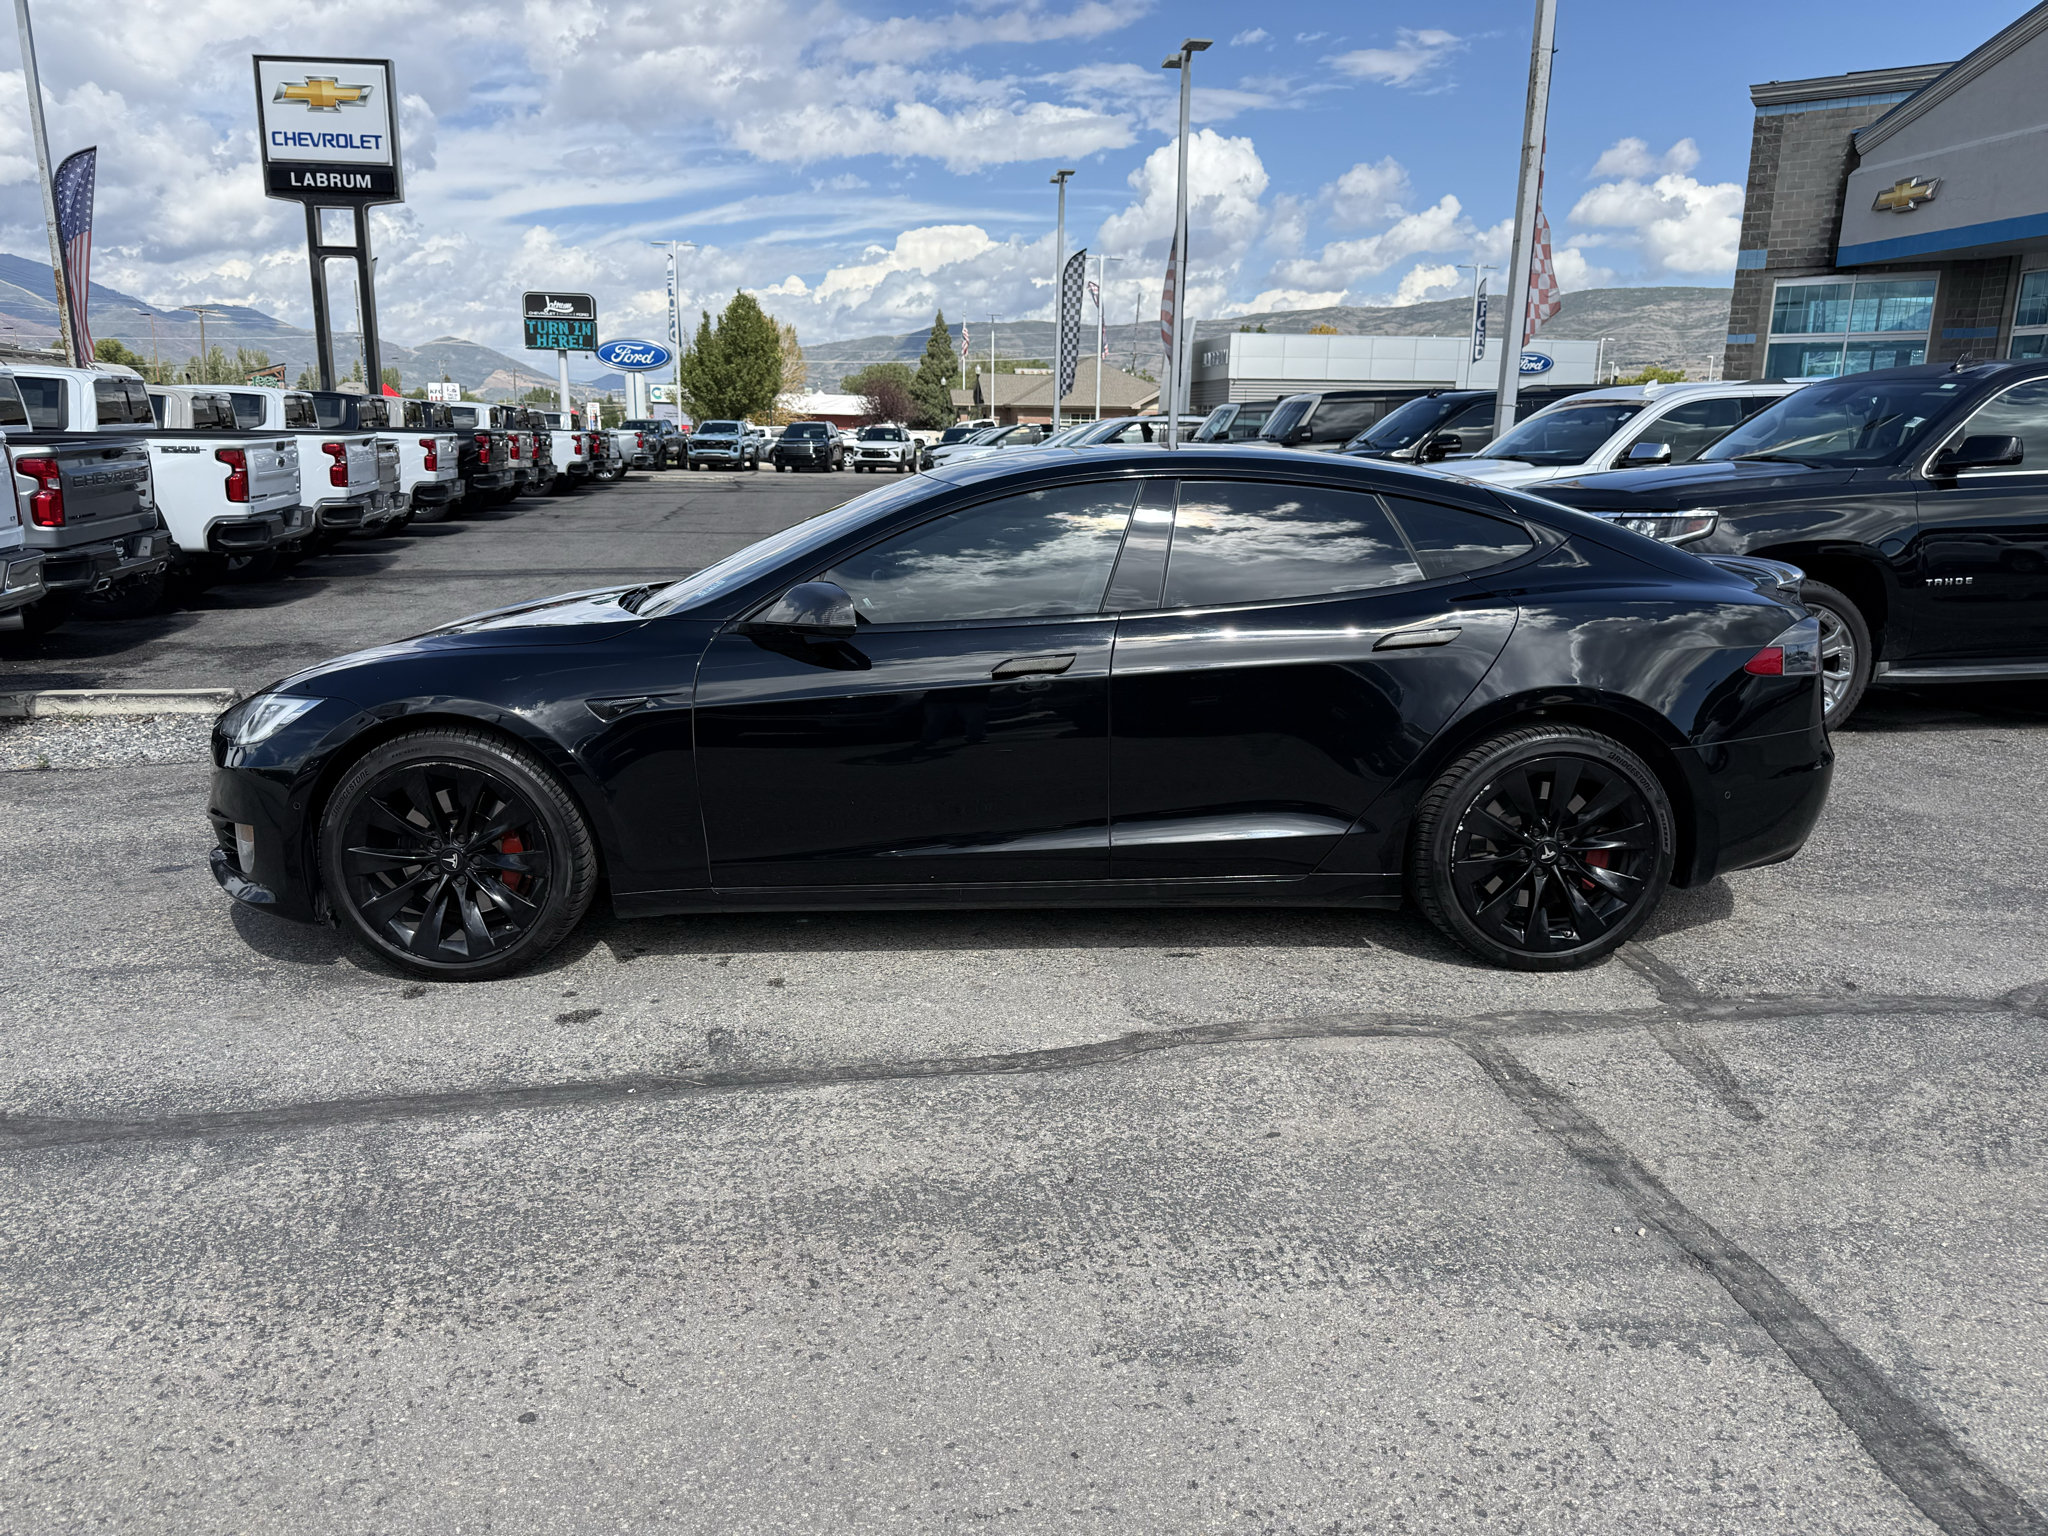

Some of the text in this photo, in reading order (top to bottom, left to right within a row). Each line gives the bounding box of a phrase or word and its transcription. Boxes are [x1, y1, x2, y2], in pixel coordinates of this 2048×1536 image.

[271, 131, 382, 150] CHEVROLET
[290, 171, 372, 189] LABRUM
[526, 320, 591, 336] TURN IN
[536, 334, 583, 348] HERE!
[611, 344, 655, 364] Ford
[1925, 577, 1973, 587] TAHOE
[1607, 751, 1654, 793] BRIDGESTONE
